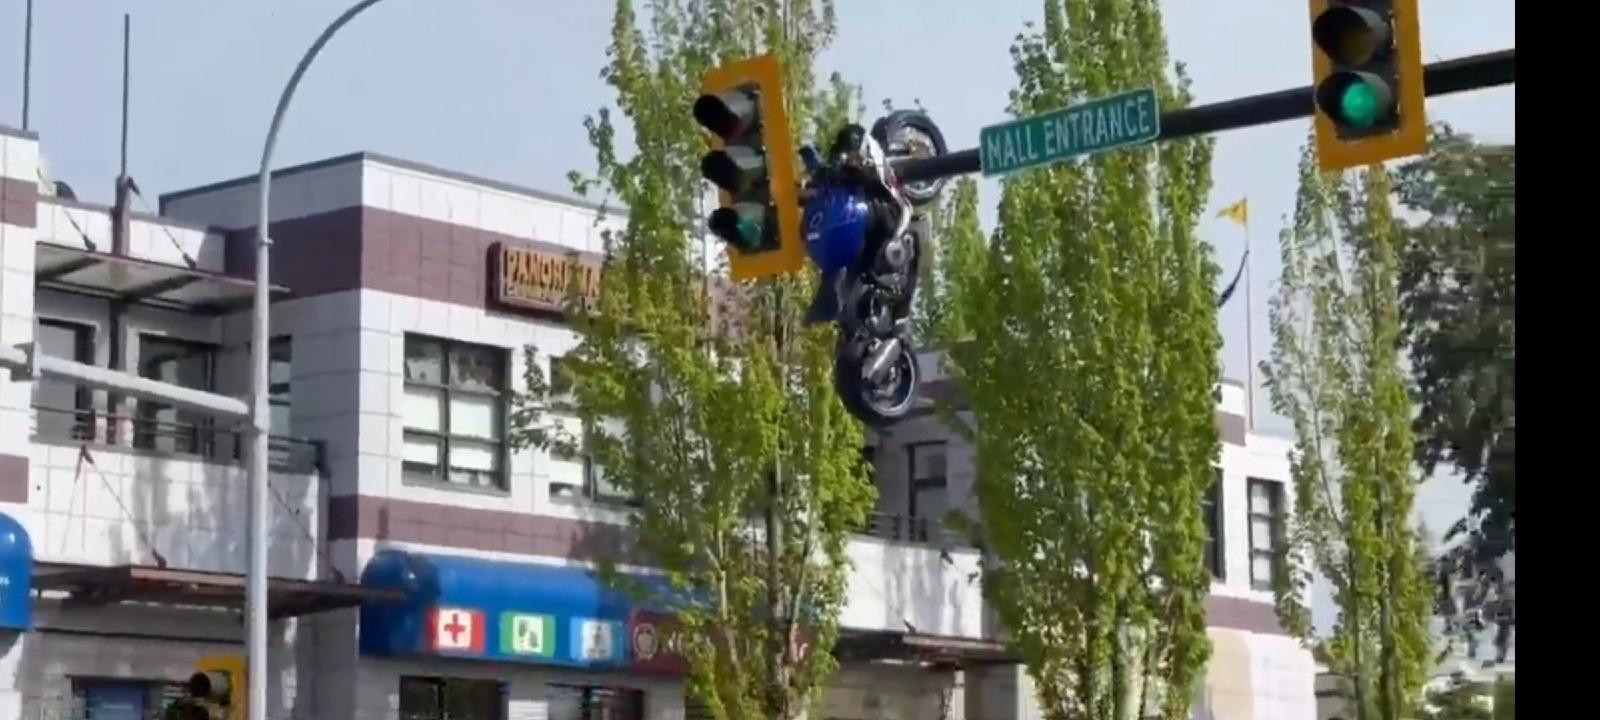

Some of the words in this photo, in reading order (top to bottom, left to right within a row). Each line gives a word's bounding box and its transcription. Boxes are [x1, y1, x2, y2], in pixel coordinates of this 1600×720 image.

[987, 125, 1038, 169] MALL
[1043, 94, 1150, 156] ENTRANCE
[506, 248, 601, 297] PANORA
